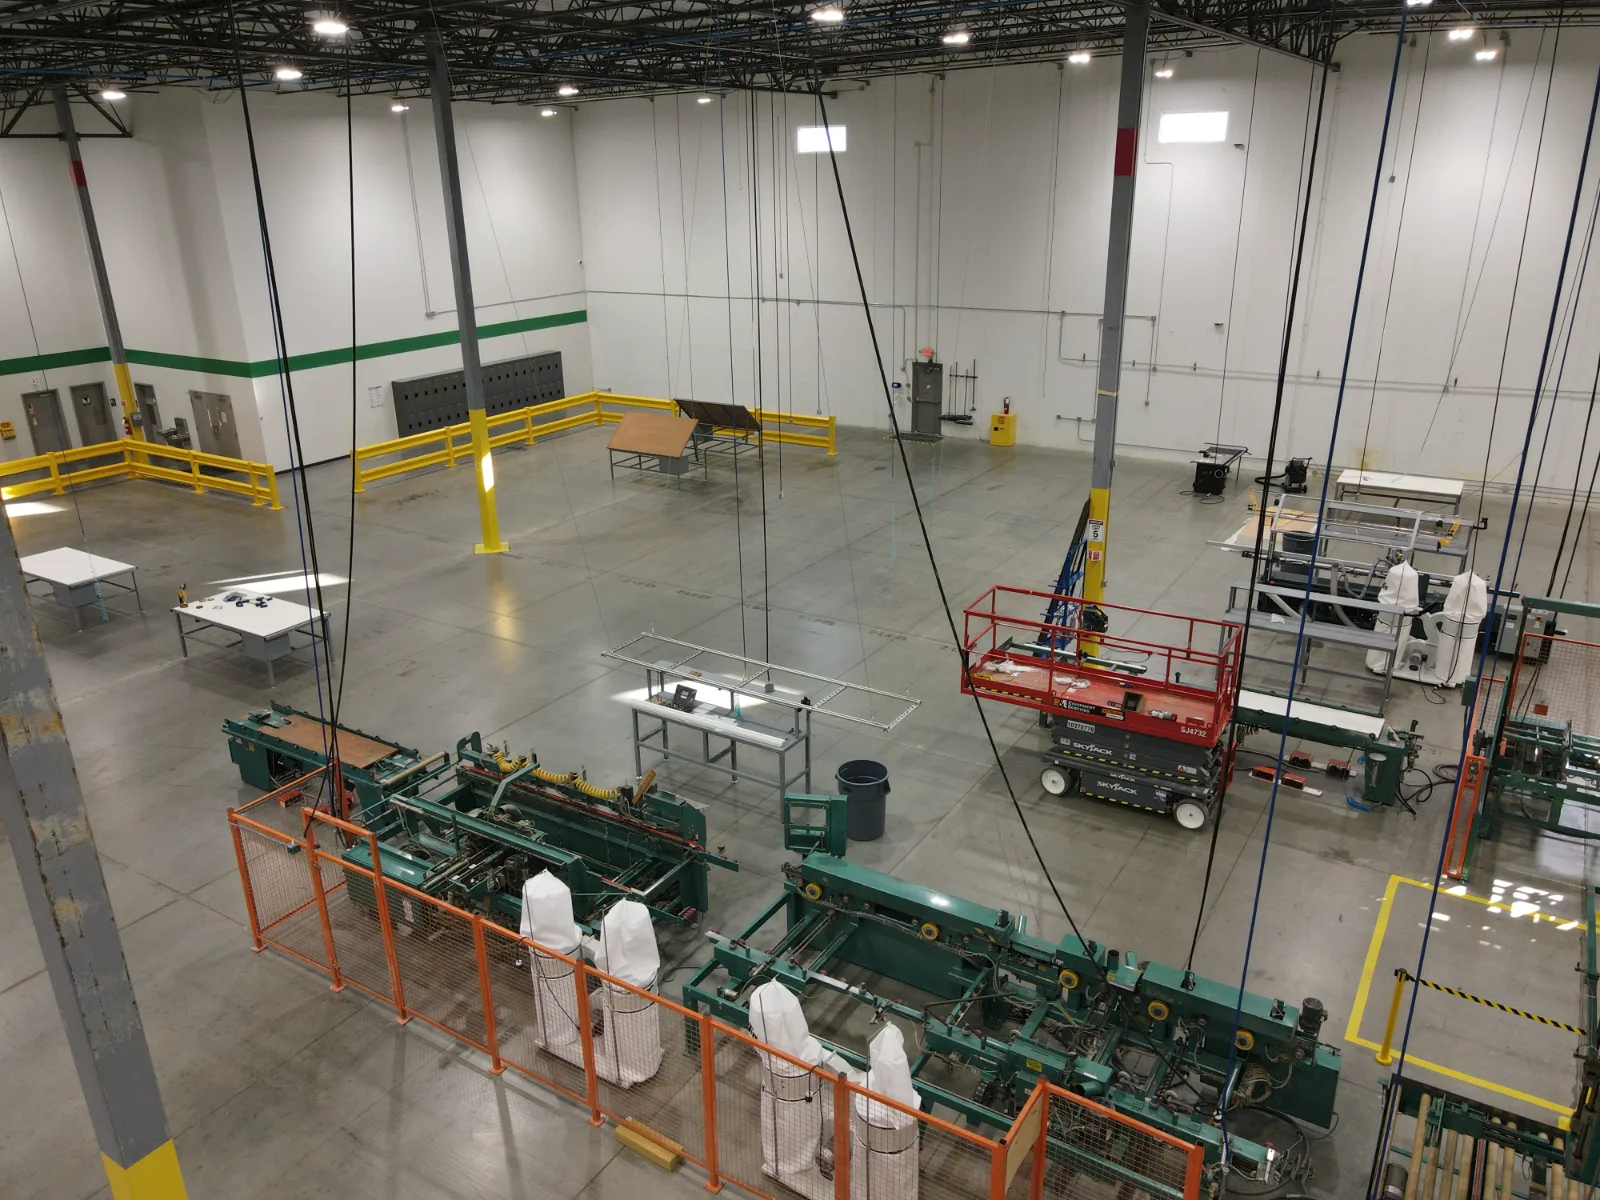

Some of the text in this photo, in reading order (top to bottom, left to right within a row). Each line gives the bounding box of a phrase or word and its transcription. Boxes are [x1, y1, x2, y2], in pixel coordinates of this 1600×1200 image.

[1180, 726, 1207, 738] SJ4732
[1073, 742, 1113, 756] SKYJACK
[1096, 780, 1138, 795] SKYJACK
